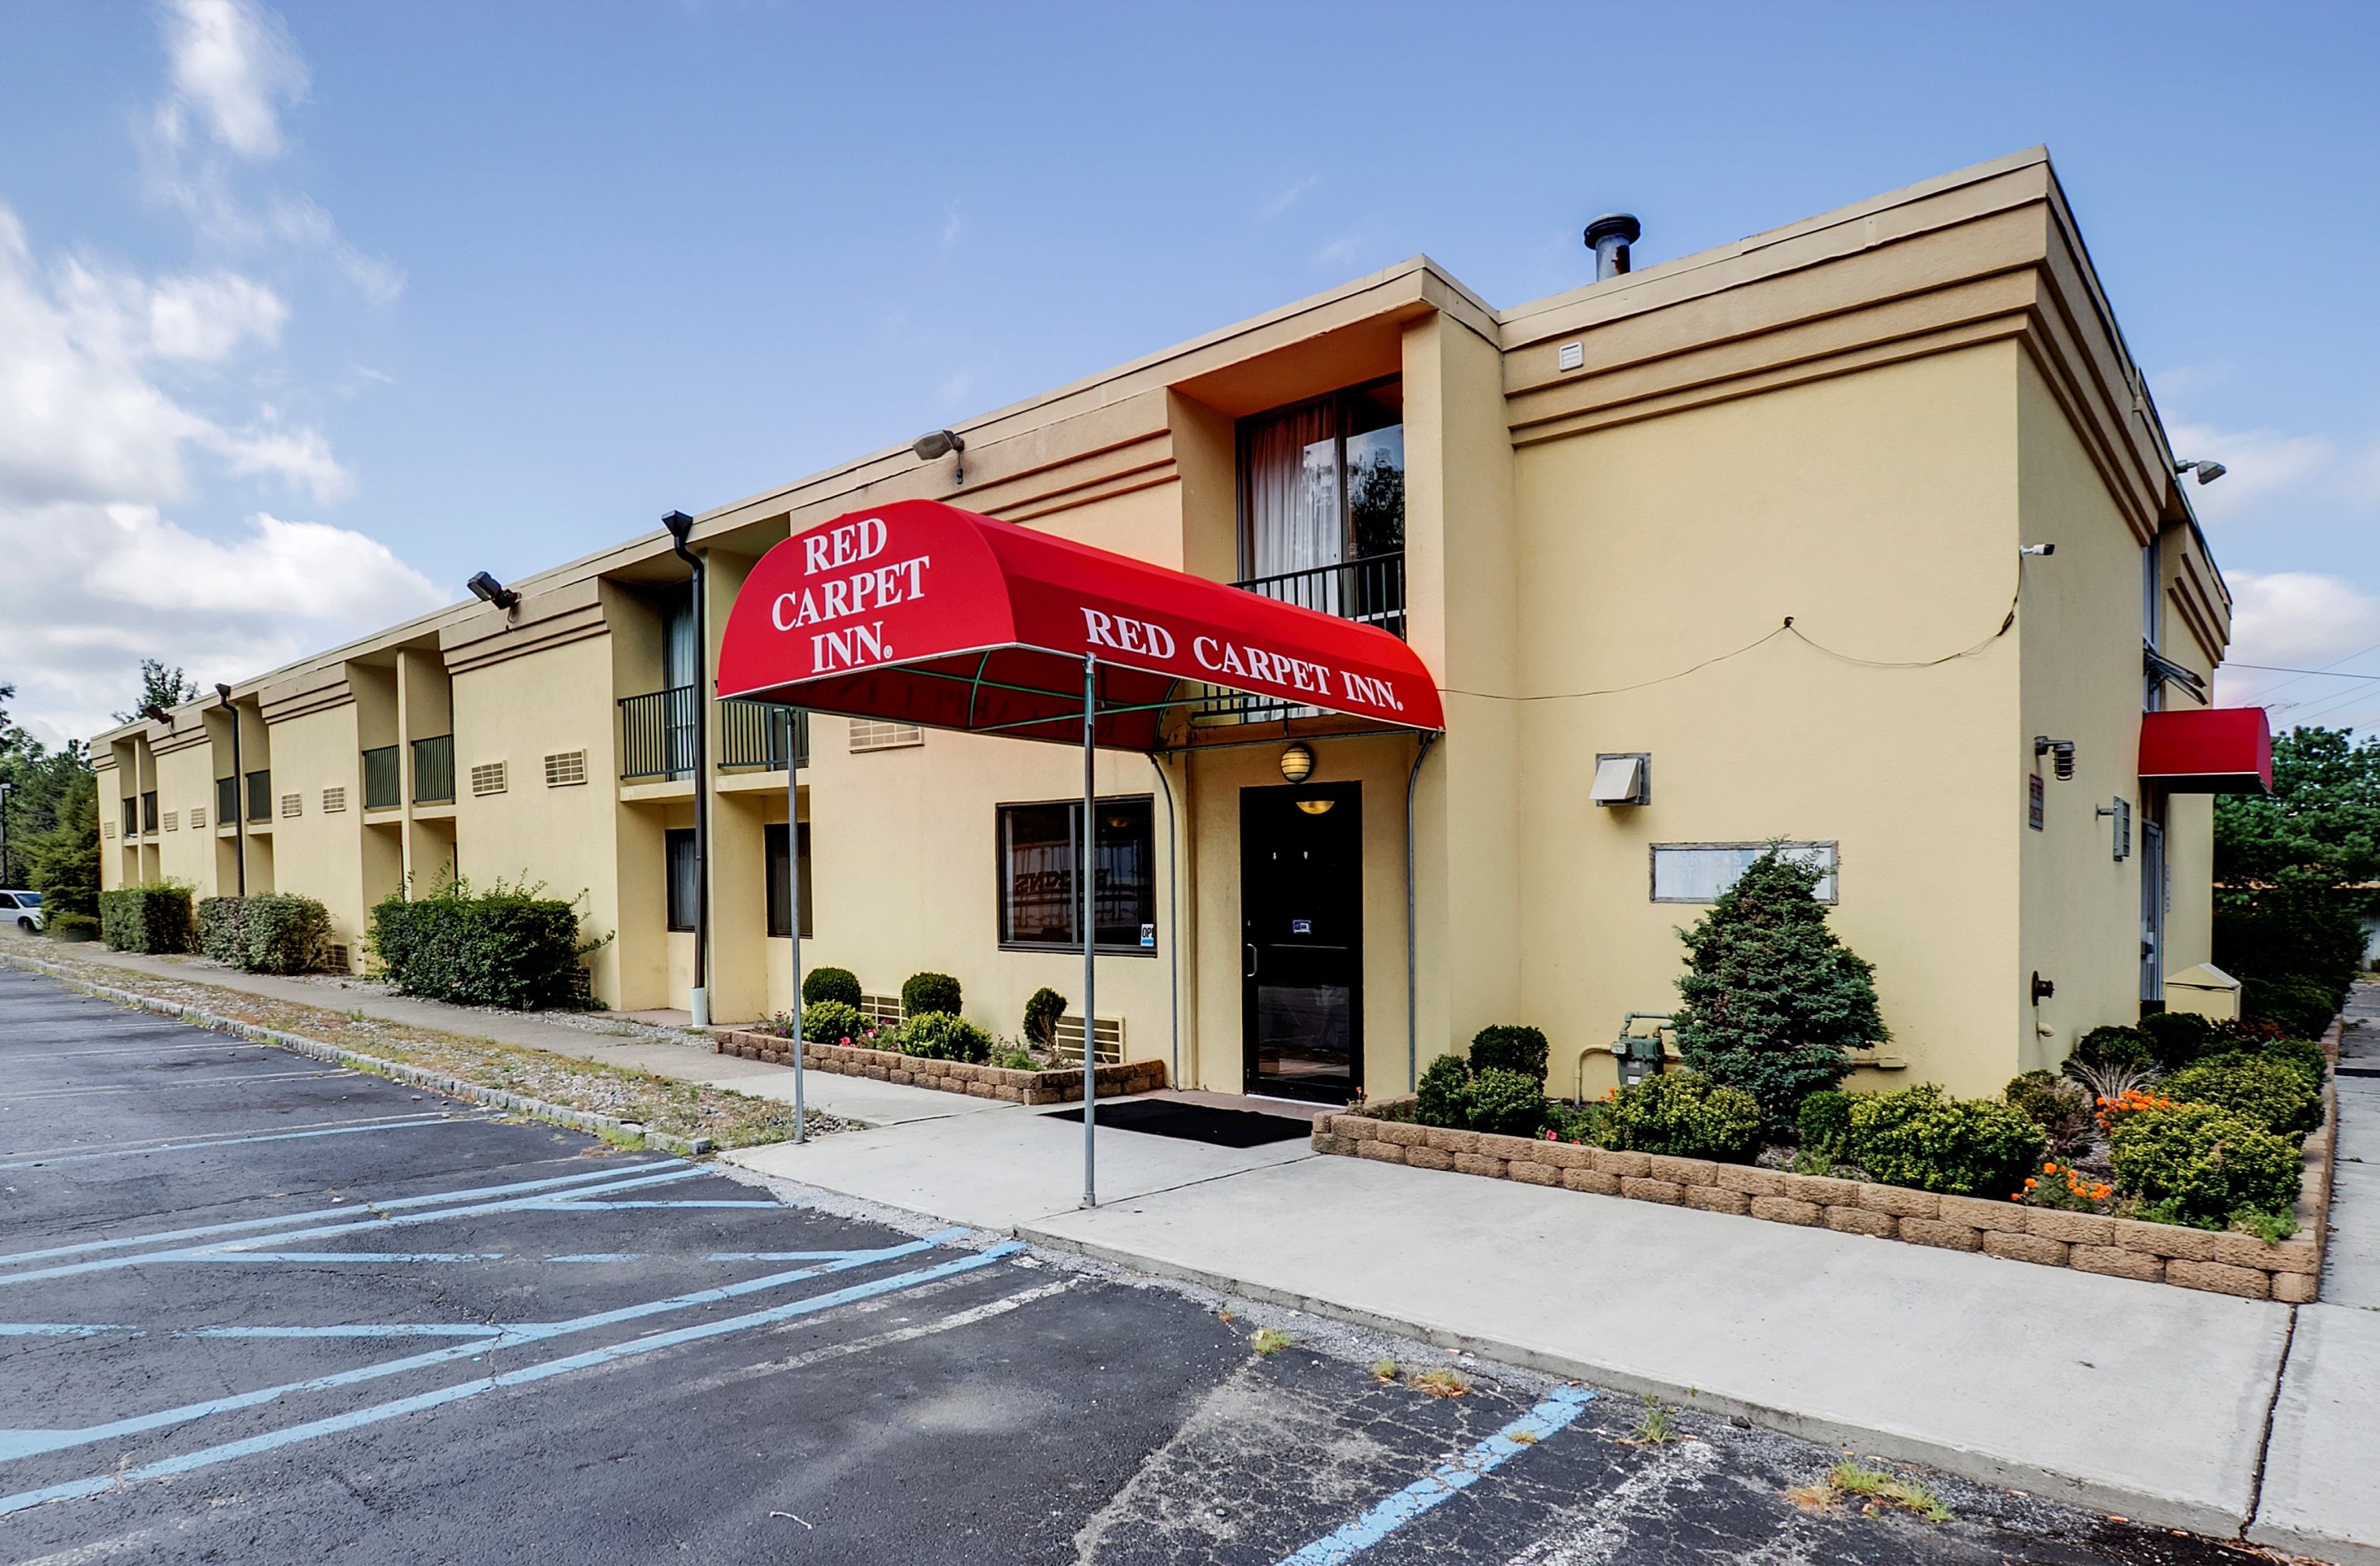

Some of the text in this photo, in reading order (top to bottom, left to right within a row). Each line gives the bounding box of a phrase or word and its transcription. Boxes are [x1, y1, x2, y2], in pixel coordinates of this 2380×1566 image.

[803, 517, 888, 576] RED
[772, 555, 930, 631] CARPET
[1080, 607, 1175, 659] RED
[1193, 636, 1331, 696] CARPET
